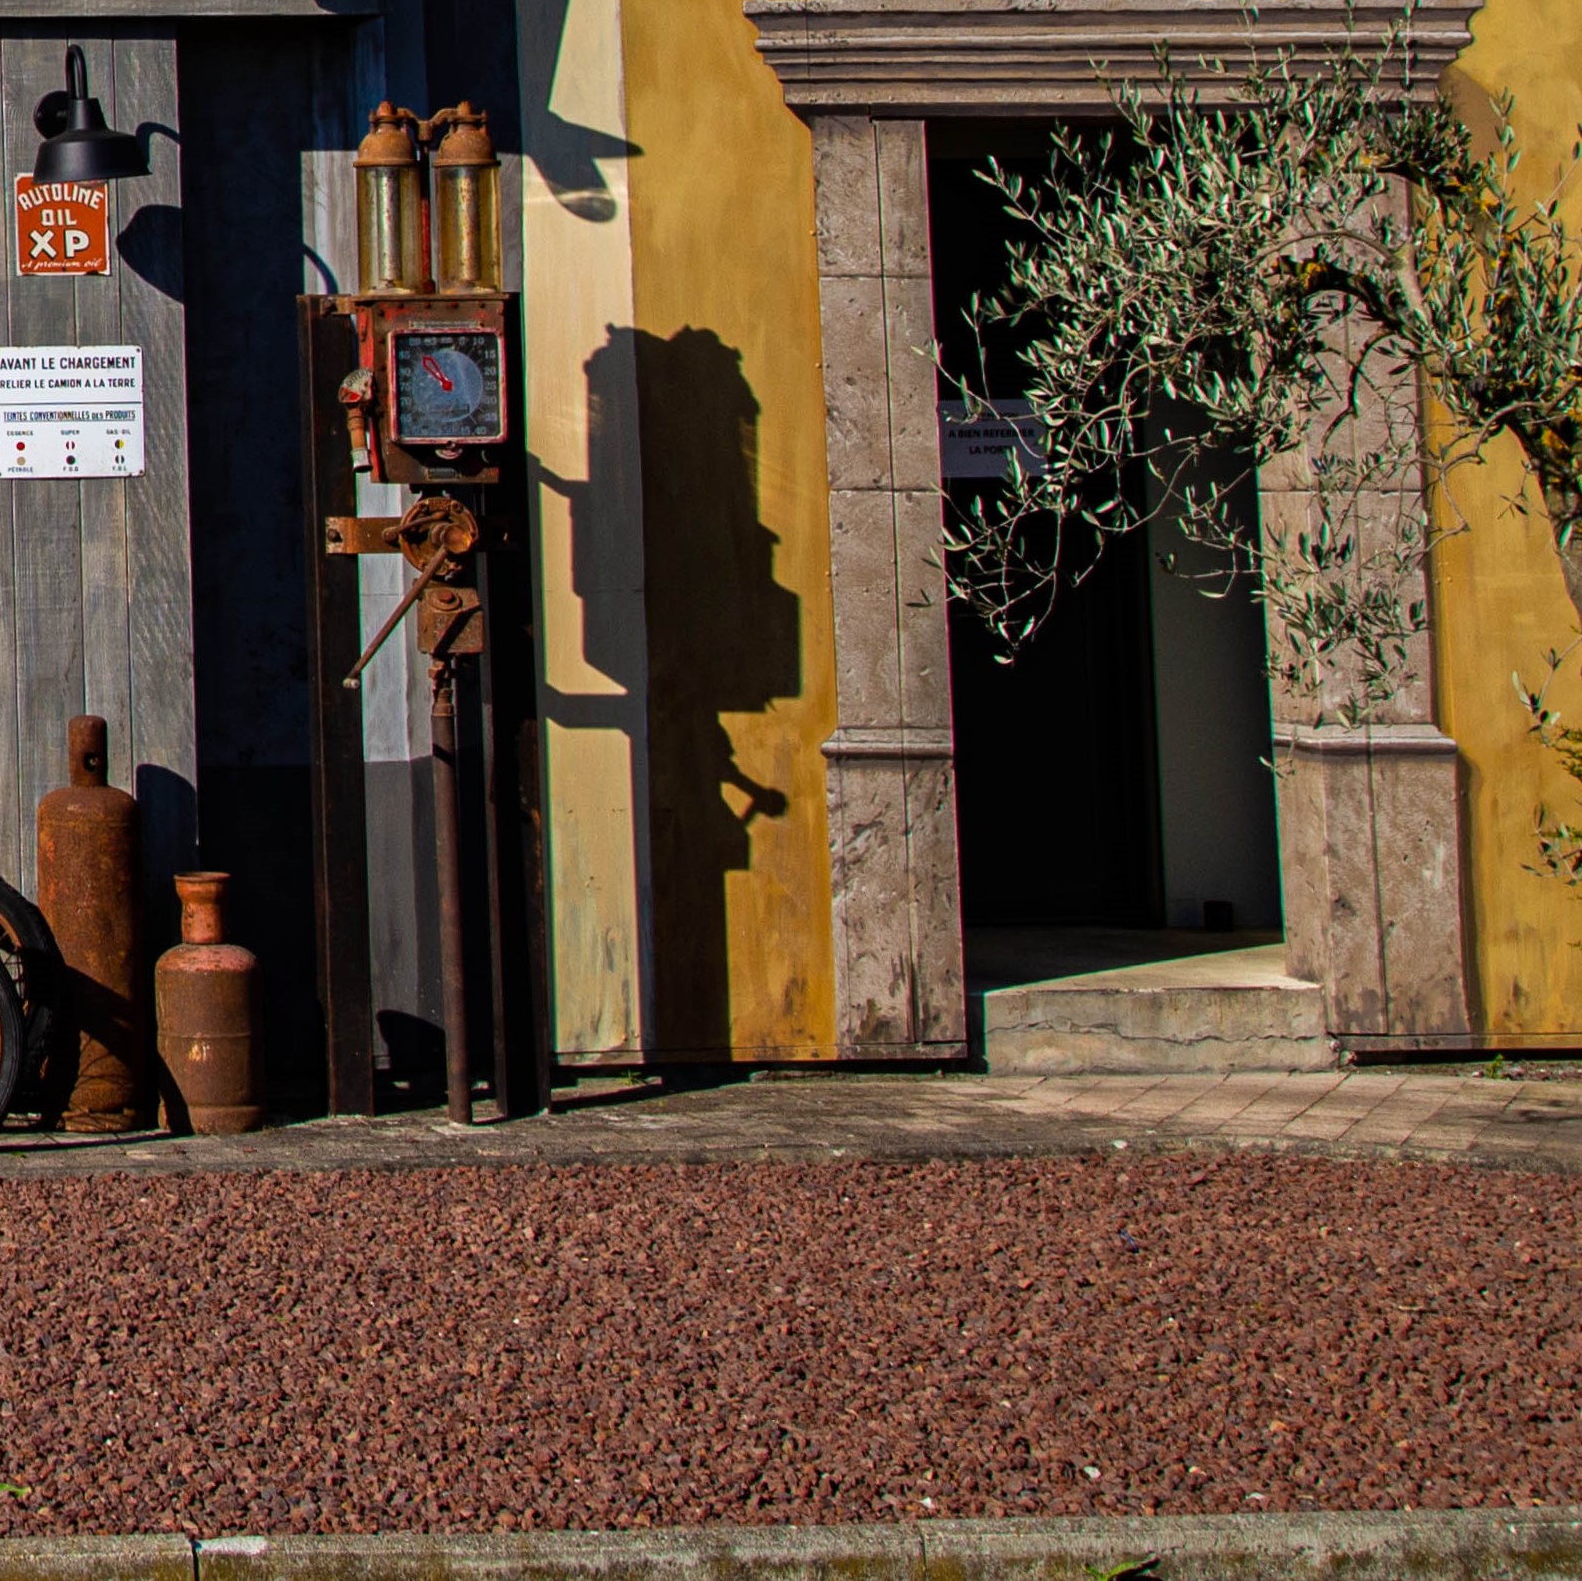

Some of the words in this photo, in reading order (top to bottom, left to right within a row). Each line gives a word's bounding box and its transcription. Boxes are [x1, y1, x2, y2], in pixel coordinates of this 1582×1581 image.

[18, 183, 104, 211] AUTOLINE
[41, 208, 78, 227] OIL
[0, 357, 37, 370] AVANT
[41, 357, 56, 370] LE
[59, 356, 136, 370] CHARGEMENT
[0, 379, 32, 389] RELIER
[34, 379, 46, 389] LE
[48, 378, 82, 389] CAMION
[84, 378, 92, 388] A
[93, 378, 106, 388] LA
[107, 378, 136, 388] TERRE
[3, 411, 28, 421] TEINTES
[29, 410, 91, 421] CONVENTIONNELLES
[105, 409, 136, 419] PRODUITS
[958, 429, 980, 438] BIEN
[969, 445, 982, 455] LA
